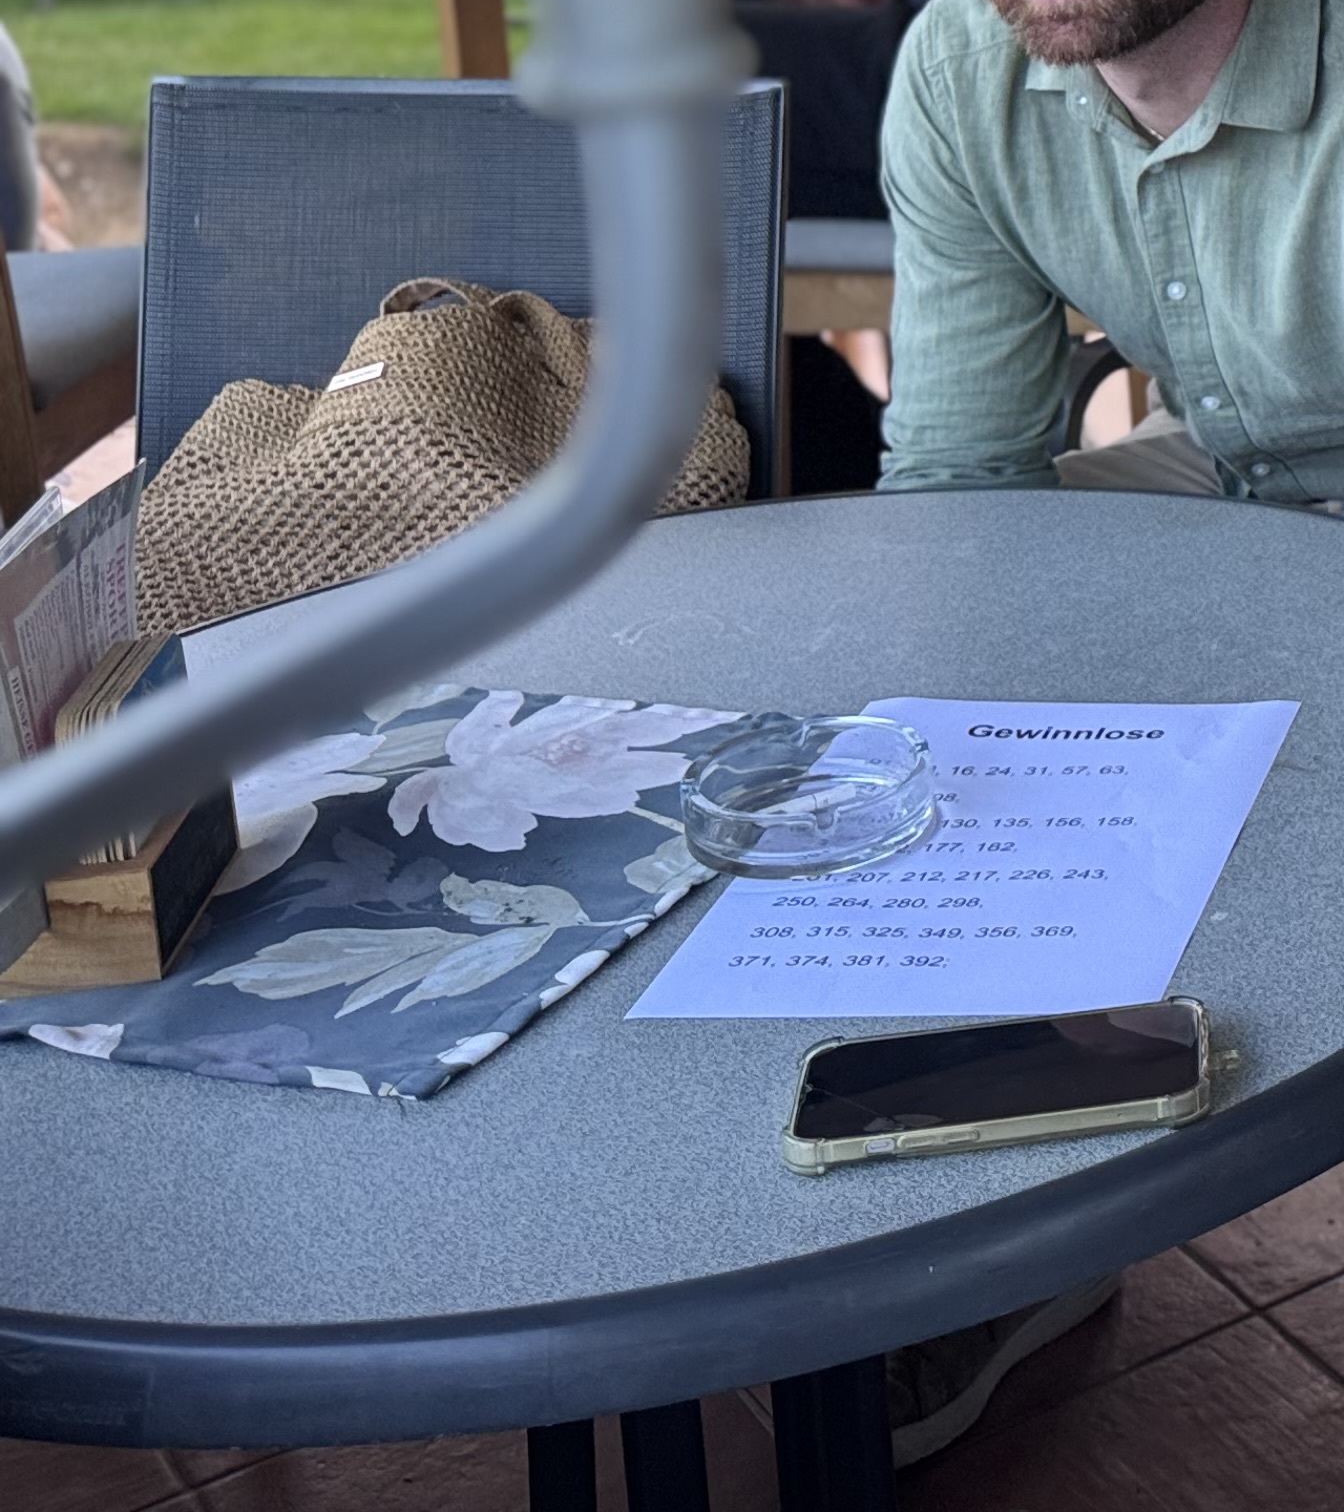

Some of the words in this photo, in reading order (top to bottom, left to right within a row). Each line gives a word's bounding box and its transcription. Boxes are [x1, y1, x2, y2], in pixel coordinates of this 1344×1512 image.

[967, 724, 1166, 740] Gewinnlose
[952, 766, 978, 777] 16,
[985, 766, 1015, 777] 24,
[1024, 766, 1053, 777] 31,
[1061, 766, 1091, 777] 57,
[1099, 765, 1129, 776] 63,
[941, 817, 981, 829] 130,
[993, 818, 1034, 829] 135,
[1045, 817, 1086, 829] 156,
[925, 842, 965, 854] 177,
[846, 872, 893, 884] 207,
[900, 871, 946, 883] 212,
[954, 871, 1001, 883] 217,
[1008, 870, 1054, 881] 226,
[1062, 869, 1109, 881] 243,
[772, 896, 820, 908] 250,
[827, 897, 873, 909] 264,
[882, 897, 929, 909] 280,
[937, 897, 983, 909] 298,
[750, 926, 796, 939] 308,
[806, 926, 852, 939] 315,
[862, 926, 908, 939] 325,
[918, 927, 965, 940] 349,
[974, 926, 1021, 939] 356,
[1031, 925, 1077, 939] 369,
[728, 955, 776, 968] 371,
[785, 955, 832, 968] 374,
[843, 954, 890, 968] 381,
